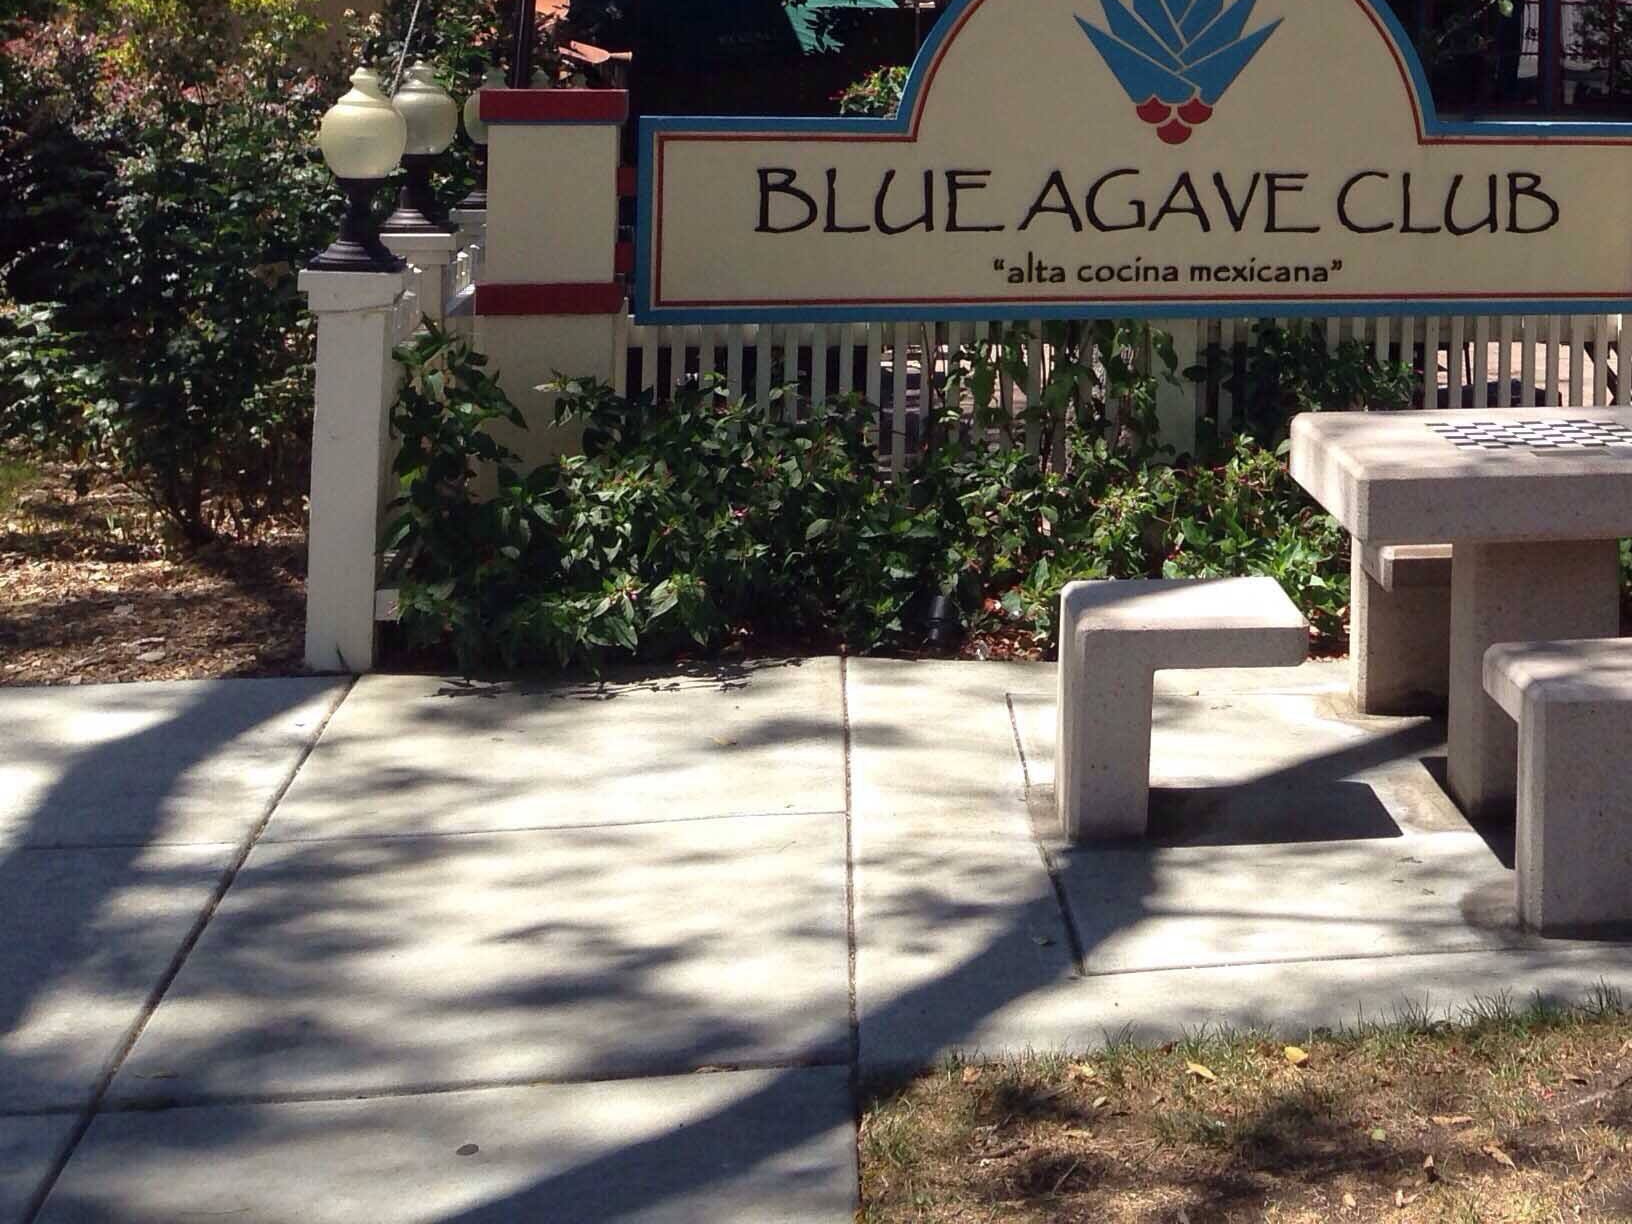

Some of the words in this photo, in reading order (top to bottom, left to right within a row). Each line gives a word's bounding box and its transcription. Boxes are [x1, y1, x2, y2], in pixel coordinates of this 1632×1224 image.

[755, 167, 1005, 235] BLUE
[1018, 169, 1320, 233] AGAVE
[1336, 170, 1560, 236] CLUB
[1077, 257, 1179, 283] cocina
